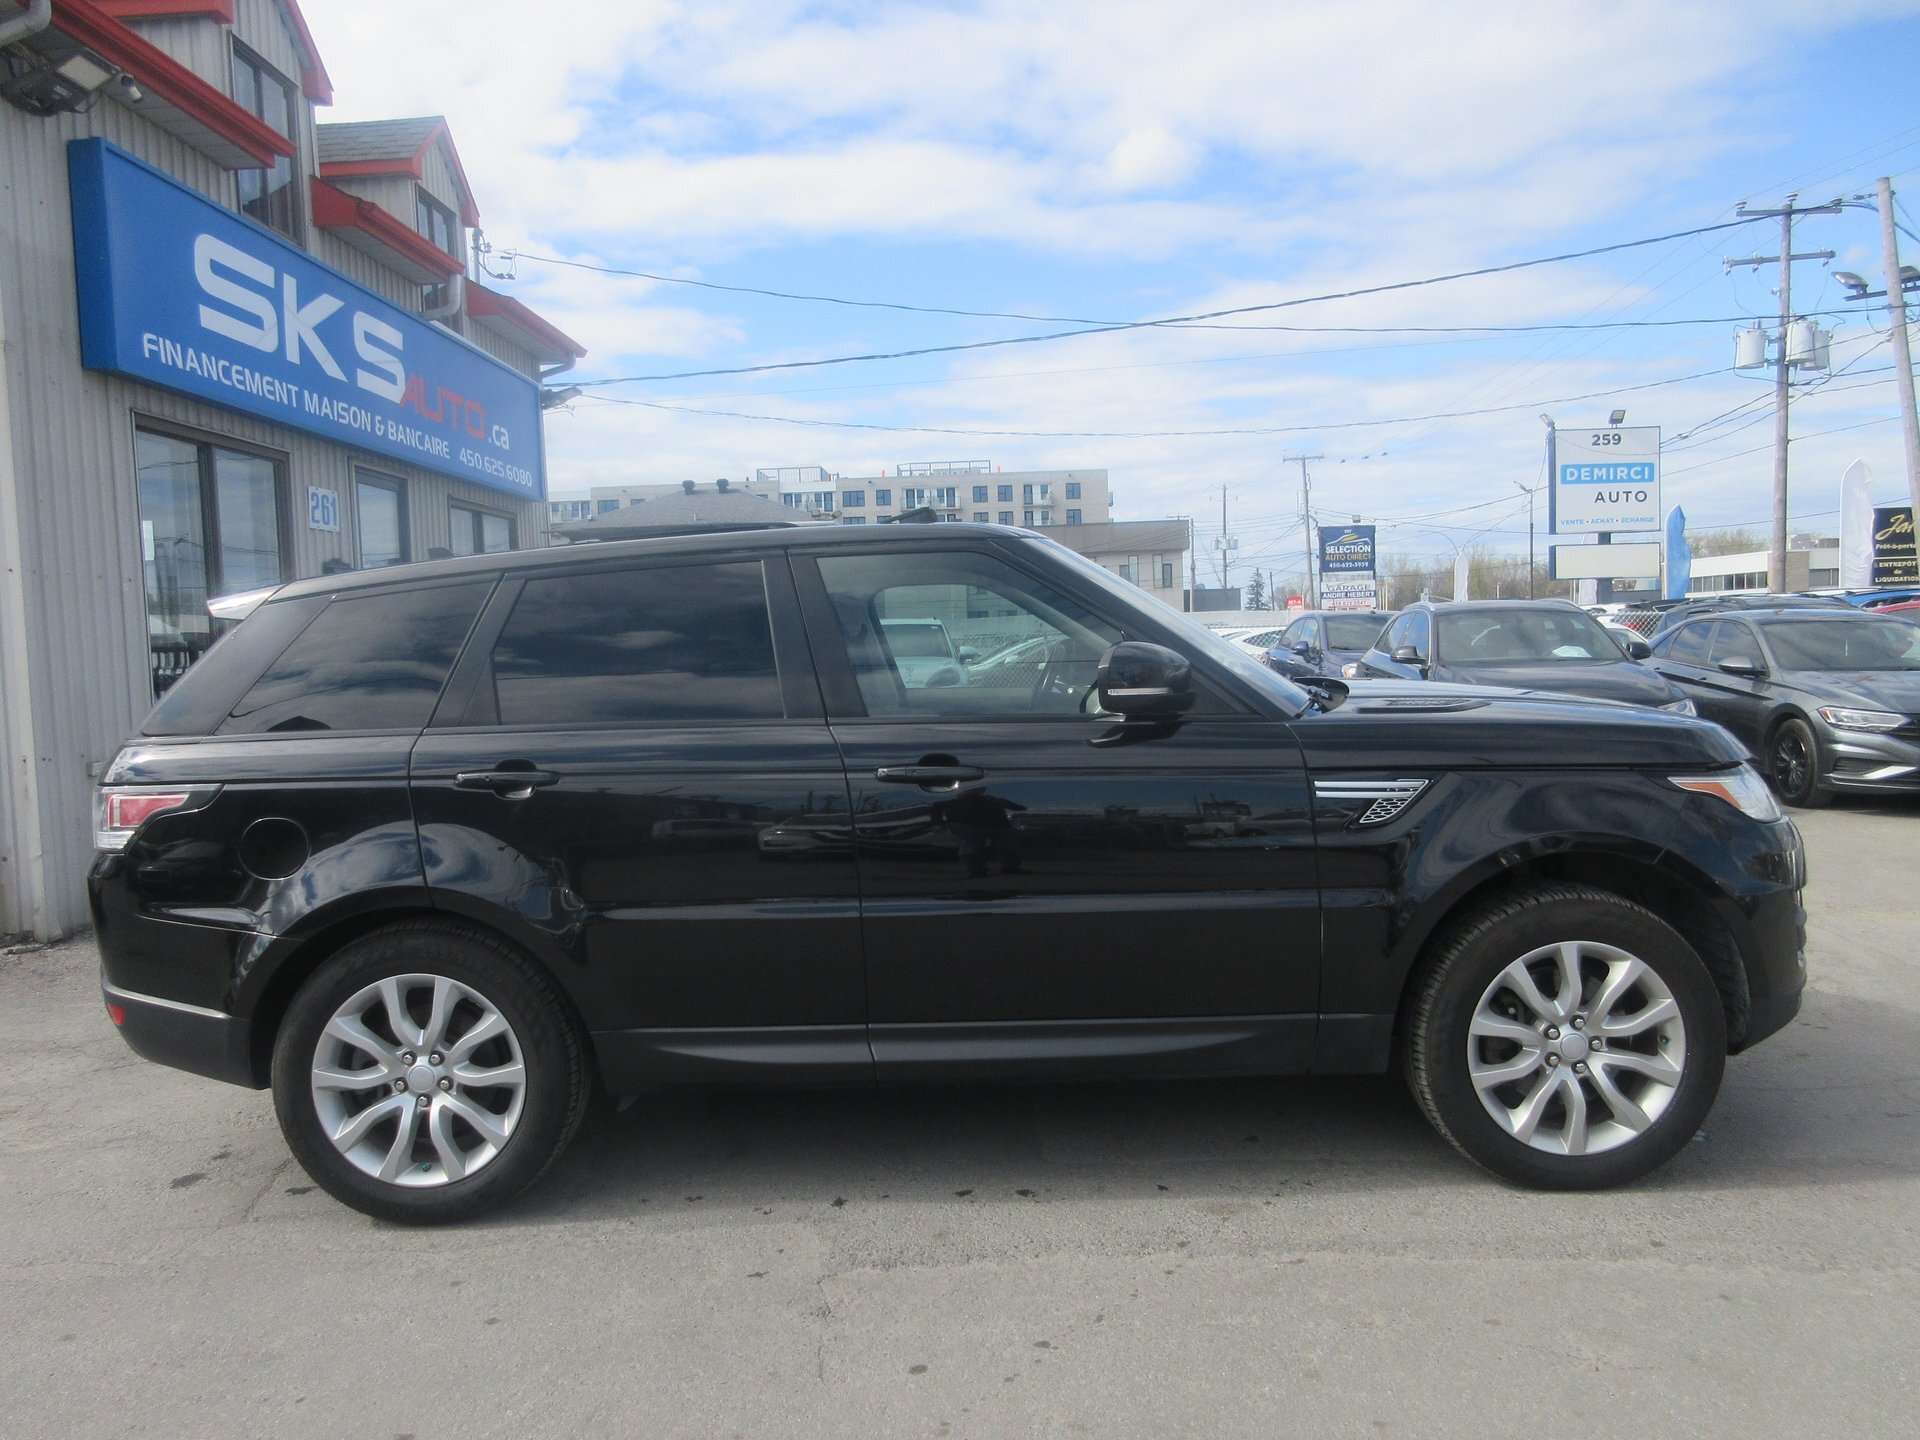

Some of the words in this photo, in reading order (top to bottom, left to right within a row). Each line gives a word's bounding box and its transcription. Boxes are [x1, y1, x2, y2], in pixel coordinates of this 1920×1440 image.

[194, 234, 405, 404] SKS
[400, 375, 487, 439] AUTO
[143, 333, 299, 408] FINANCEMENT
[304, 390, 372, 433] MAISON
[375, 415, 385, 437] &
[388, 422, 451, 459] BANCAIRE
[1592, 433, 1622, 446] 259
[1566, 466, 1649, 481] DEMIRCI
[1594, 490, 1648, 503] AUTO
[311, 491, 337, 526] 261
[1325, 545, 1371, 553] SELECTION
[1325, 553, 1345, 561] AUTO
